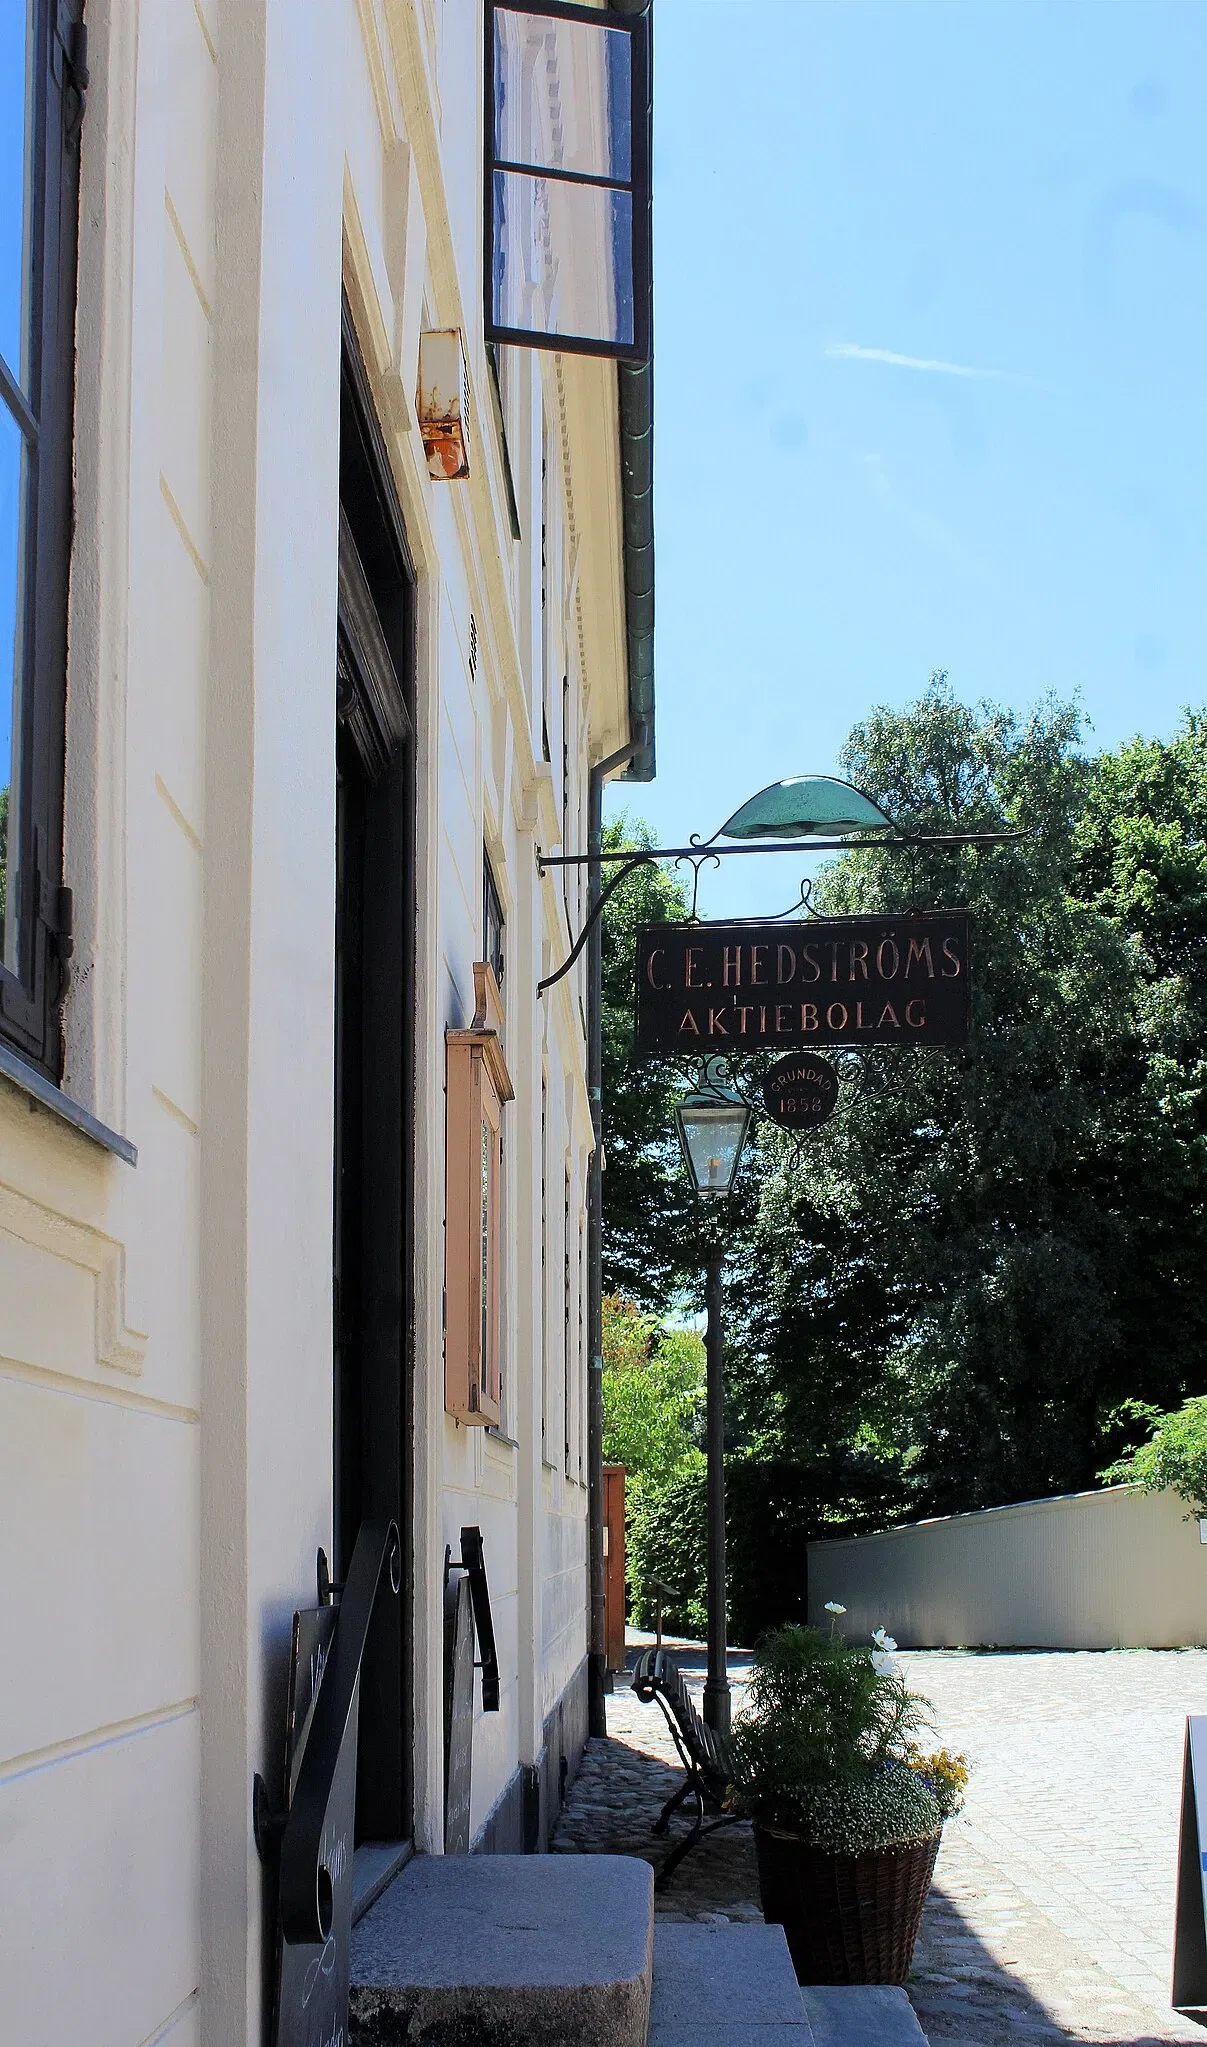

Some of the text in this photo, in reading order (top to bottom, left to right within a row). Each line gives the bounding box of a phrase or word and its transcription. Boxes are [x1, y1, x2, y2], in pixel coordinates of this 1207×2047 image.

[646, 931, 961, 990] C. E. HEDSTRÖMS
[678, 1000, 926, 1036] AKTIEBOLAG
[771, 1068, 832, 1092] GRUNDAD
[780, 1097, 821, 1113] 1858
